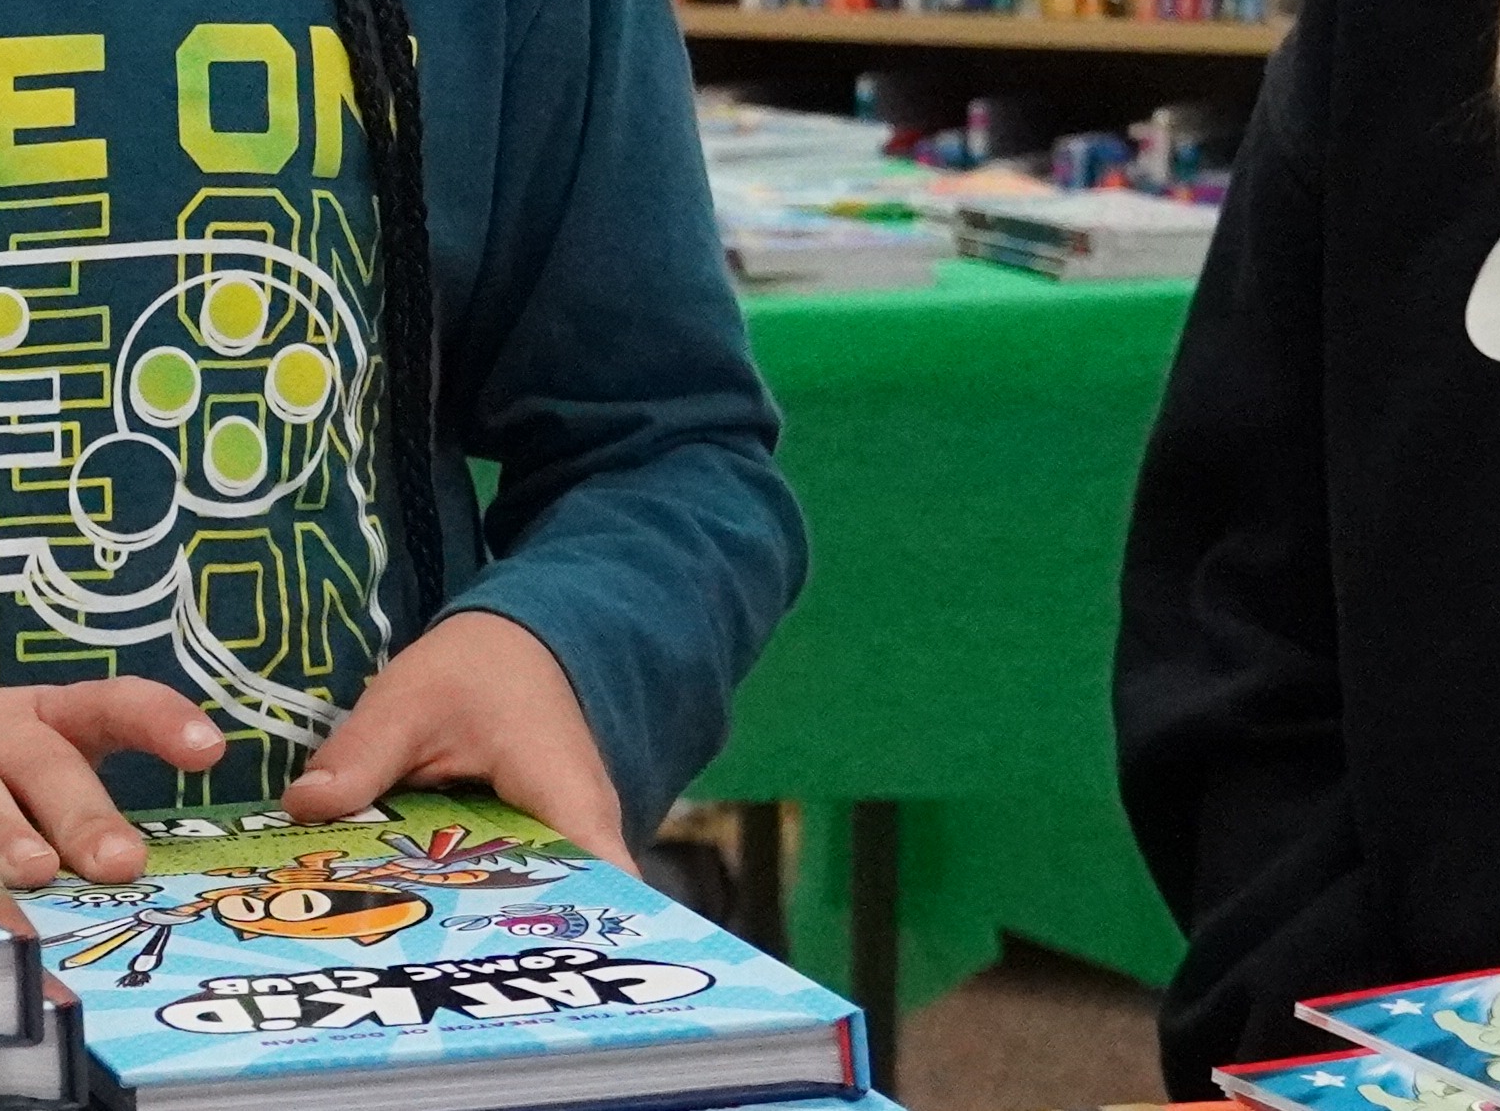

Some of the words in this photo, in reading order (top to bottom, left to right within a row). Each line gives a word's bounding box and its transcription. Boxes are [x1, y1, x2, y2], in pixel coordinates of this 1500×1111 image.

[177, 23, 416, 177] ON
[178, 187, 382, 343] ON
[185, 515, 388, 686] ON
[207, 970, 380, 995] CLUB
[450, 964, 711, 1019] CAT
[569, 1012, 616, 1022] THE
[626, 1004, 697, 1016] FROM
[441, 1017, 556, 1032] CREATOR
[328, 1032, 387, 1041] DOG
[397, 1028, 428, 1037] OF
[261, 1037, 319, 1047] MAN
